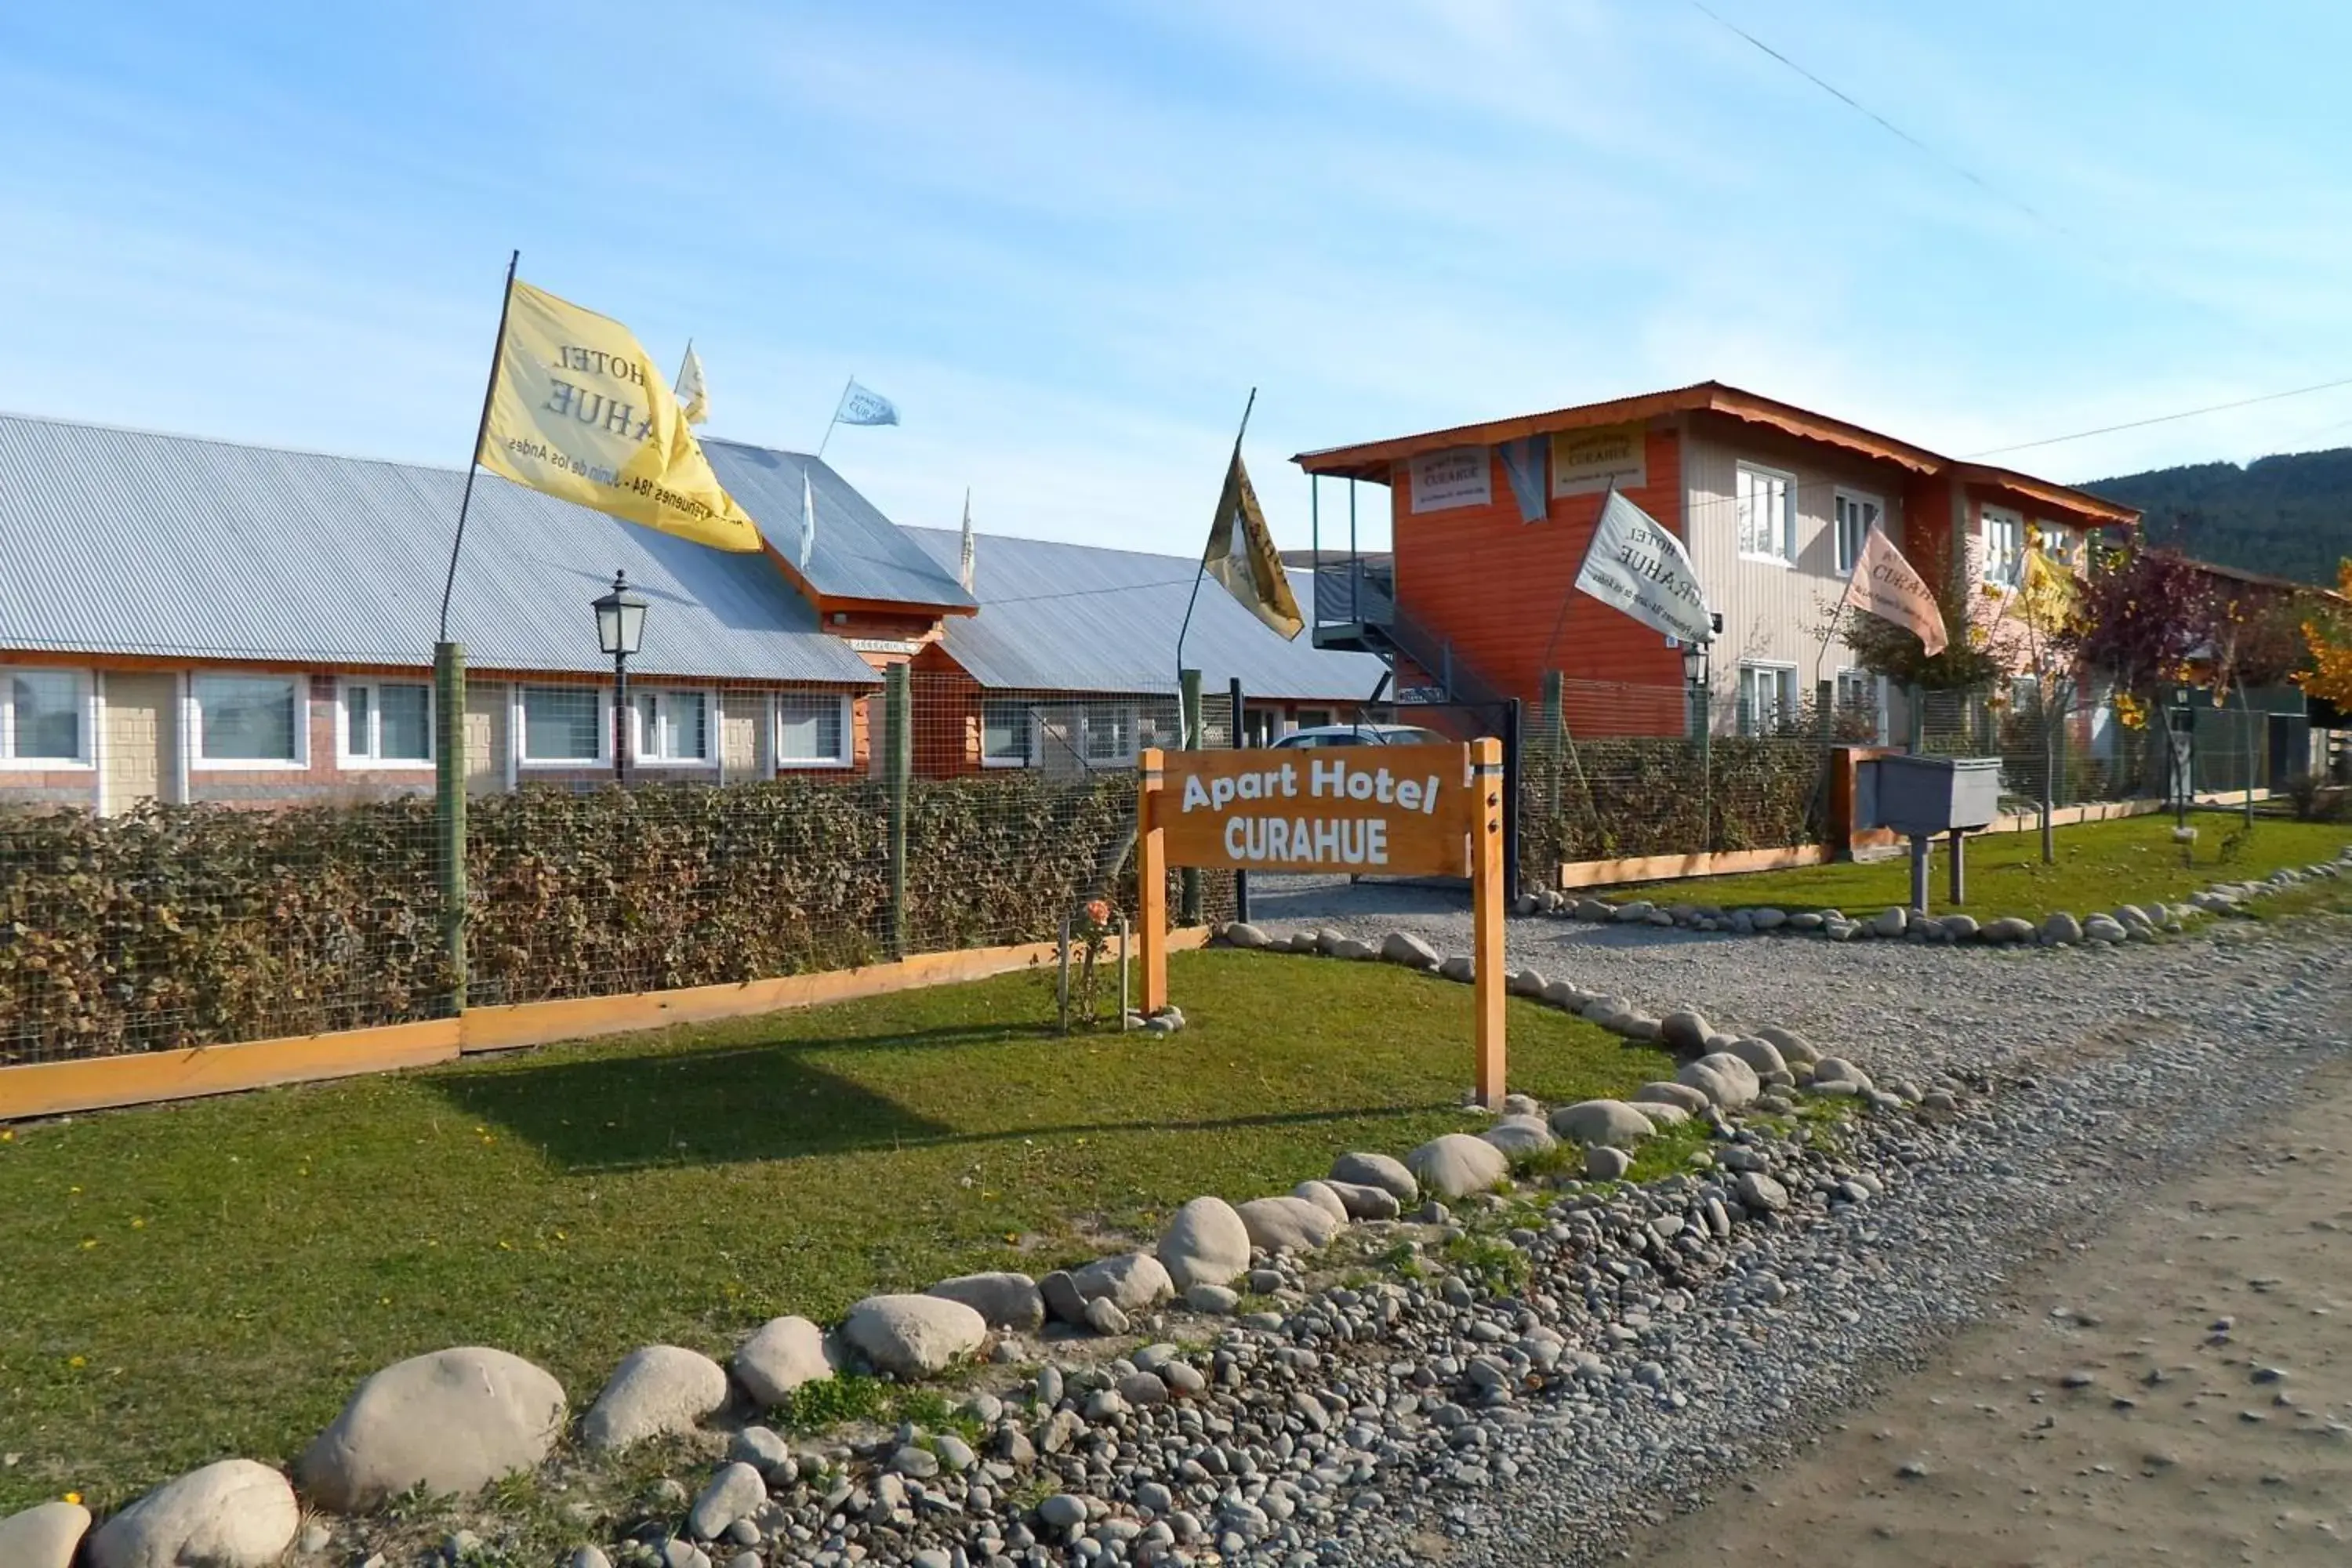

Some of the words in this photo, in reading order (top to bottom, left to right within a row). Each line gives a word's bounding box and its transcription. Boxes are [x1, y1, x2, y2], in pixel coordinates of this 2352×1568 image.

[1181, 763, 1298, 813] Apart
[1311, 759, 1440, 815] Hotel
[1225, 816, 1388, 865] CURAHUE
